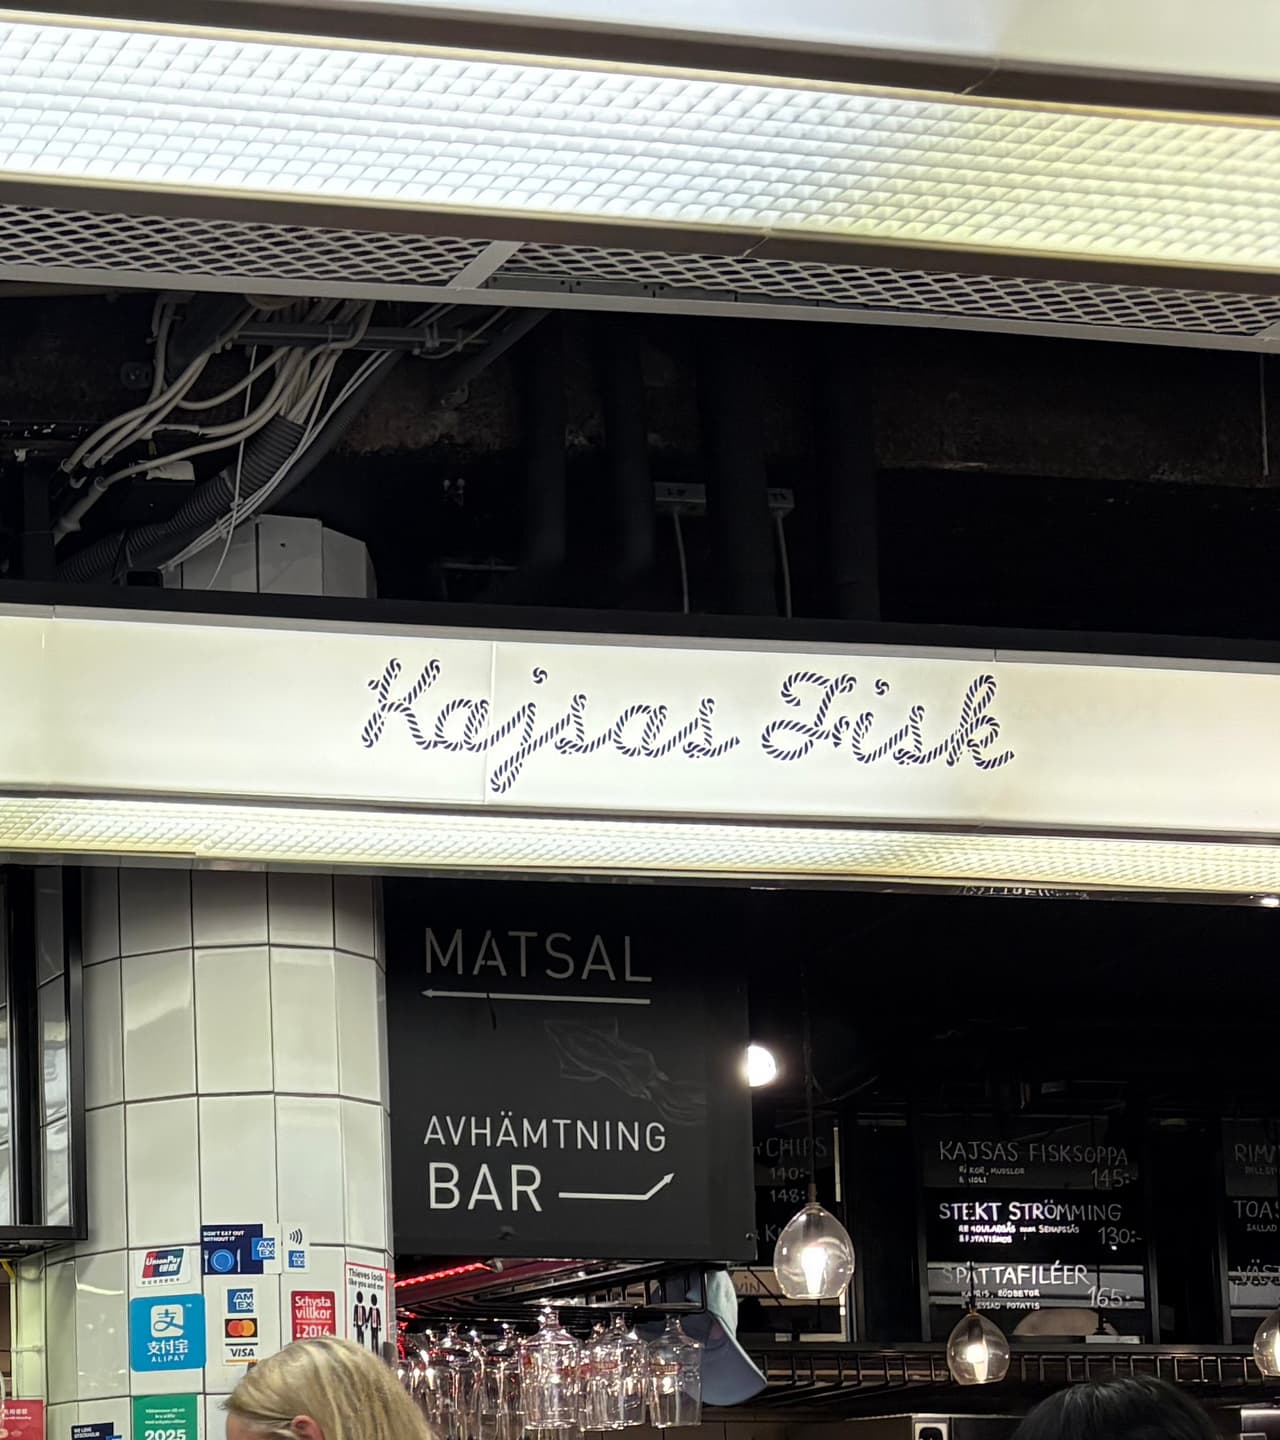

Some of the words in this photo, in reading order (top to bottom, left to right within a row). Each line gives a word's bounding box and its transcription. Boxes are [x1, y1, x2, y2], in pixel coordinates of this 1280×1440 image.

[360, 657, 740, 794] Kajsas
[761, 670, 1015, 770] Fisk
[425, 928, 652, 982] MATSAL
[423, 1111, 666, 1152] AVHÄMTNING
[940, 1141, 1019, 1161] KAJSAS
[1030, 1144, 1128, 1165] FISKSOPPA
[429, 1162, 542, 1212] BAR
[939, 1202, 1002, 1221] STEKT
[1009, 1199, 1122, 1221] STRÖMMING
[943, 1260, 1090, 1285] SPÄTTAFILÉER
[295, 1295, 331, 1311] Schysta
[295, 1307, 331, 1320] villkor
[147, 1340, 189, 1355] 支付宝
[151, 1355, 185, 1363] ALIPAY
[231, 1348, 255, 1357] VISA
